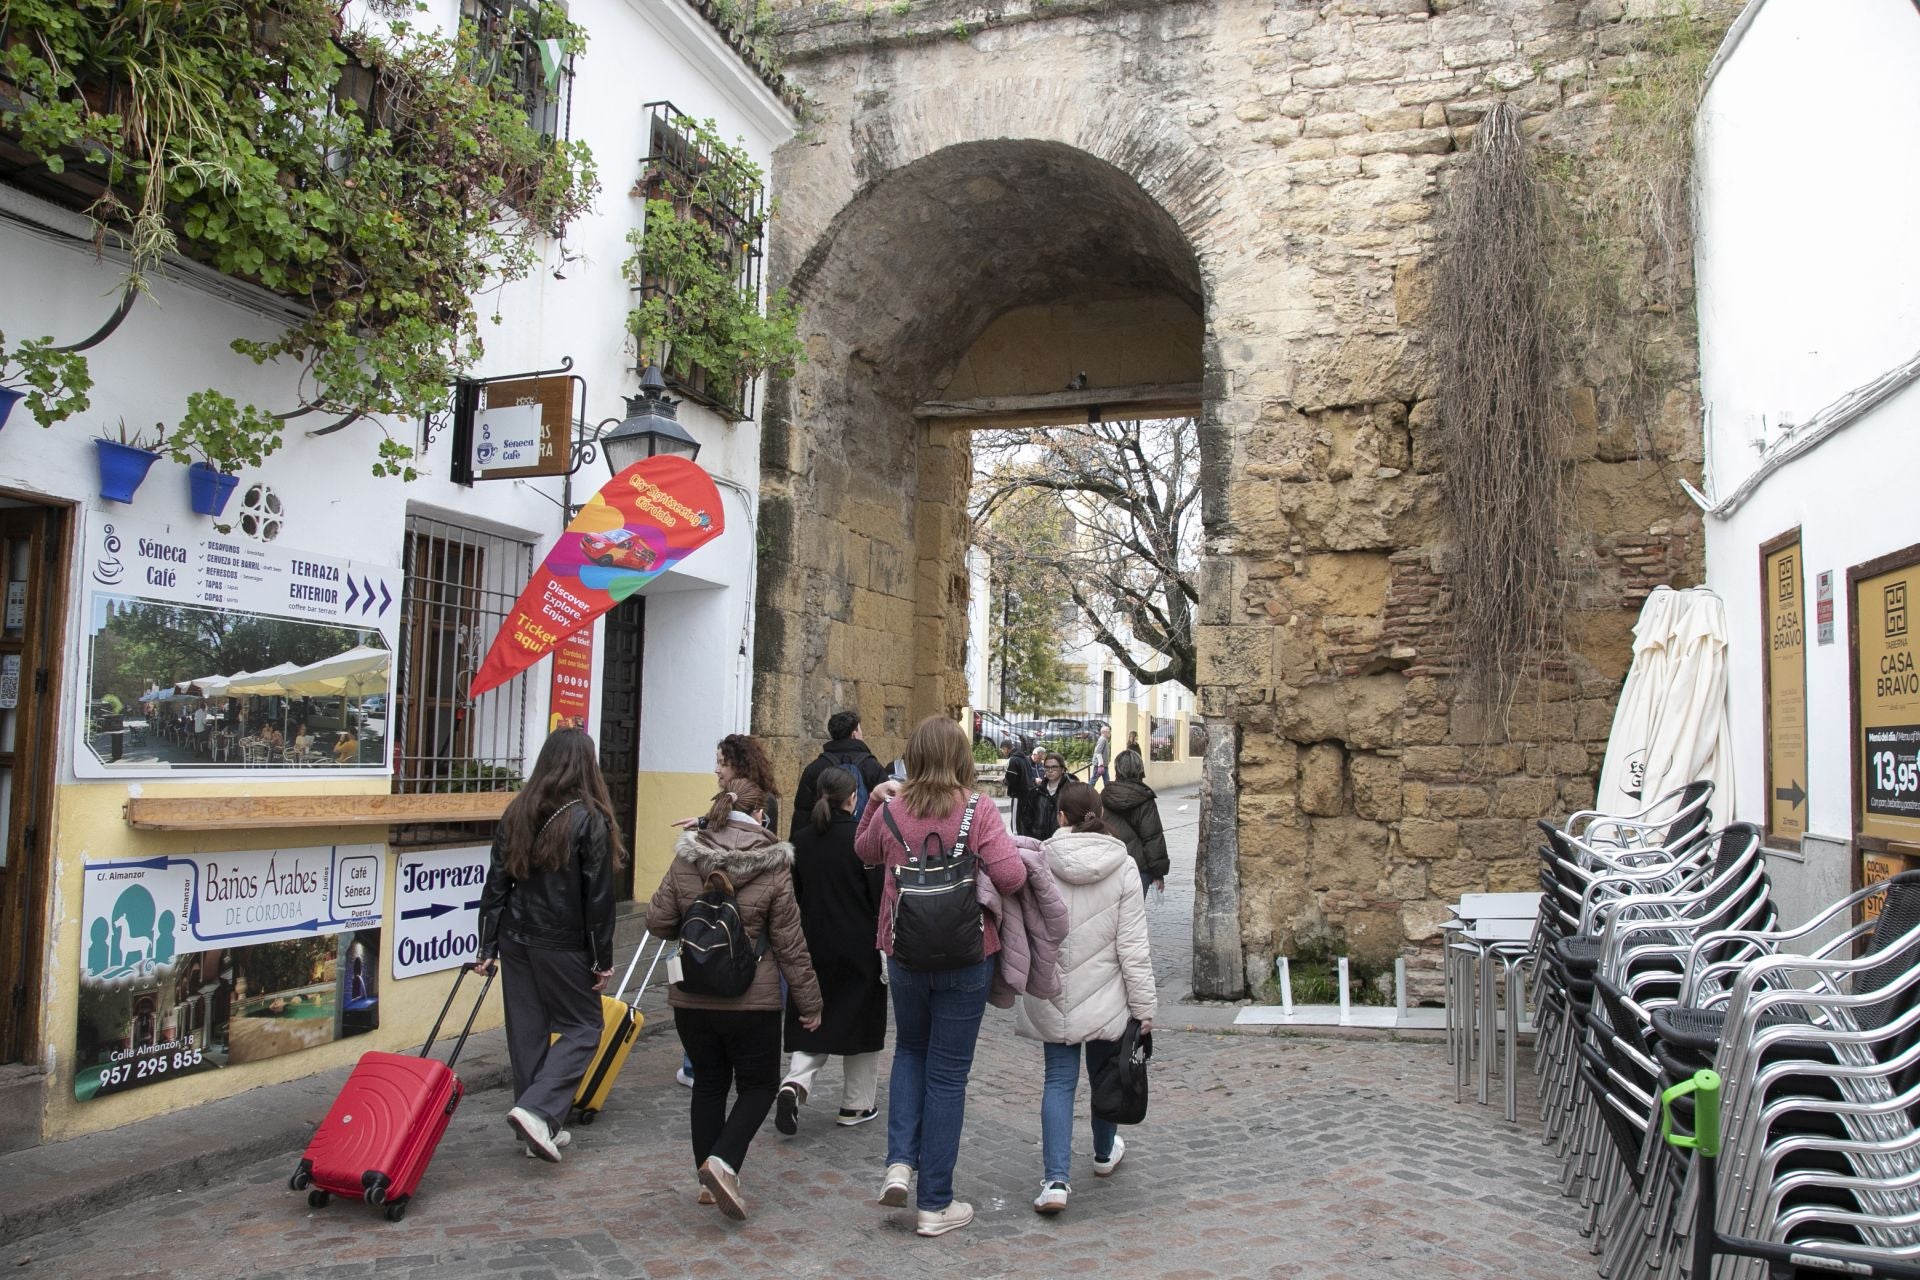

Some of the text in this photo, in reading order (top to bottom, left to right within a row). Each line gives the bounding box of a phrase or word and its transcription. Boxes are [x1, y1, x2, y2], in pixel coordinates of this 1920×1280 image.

[138, 537, 187, 564] Séneca
[208, 541, 240, 555] DESAYUNOS
[206, 553, 231, 566] CERVEZA
[232, 558, 240, 568] DE
[241, 560, 260, 571] BARRIL
[206, 566, 238, 580] REFRESCOS
[291, 560, 339, 582] TERRAZA
[146, 565, 176, 588] Café
[205, 579, 223, 590] TAPAS
[204, 592, 223, 603] COPAS
[290, 583, 338, 604] EXTERIOR
[547, 580, 590, 612] Discover.
[288, 603, 337, 616] coffee bar terrace
[542, 604, 571, 627] Enjoy.
[543, 591, 582, 620] Explore.
[517, 613, 558, 646] Ticket
[1776, 611, 1798, 632] CASA
[514, 631, 547, 653] aquí
[1774, 628, 1801, 651] BRAVO
[1885, 638, 1908, 649] TABERNA
[1881, 651, 1914, 675] CASA
[1877, 673, 1919, 697] BRAVO
[958, 808, 975, 837] BIMBA
[109, 870, 145, 881] Almanzor
[205, 849, 317, 902] Baños Árabes
[351, 866, 368, 880] Café
[403, 862, 484, 894] Terraza
[1867, 860, 1889, 875] COCINA
[182, 879, 191, 918] Almanzor
[345, 884, 371, 898] Séneca
[226, 899, 303, 926] DE CÓRDOBA
[351, 909, 372, 917] Puerta
[1867, 896, 1884, 912] STO
[398, 929, 478, 967] Outdoo
[110, 1035, 194, 1061] Calle Almanzor, 18
[100, 1048, 203, 1087] 957 295 855
